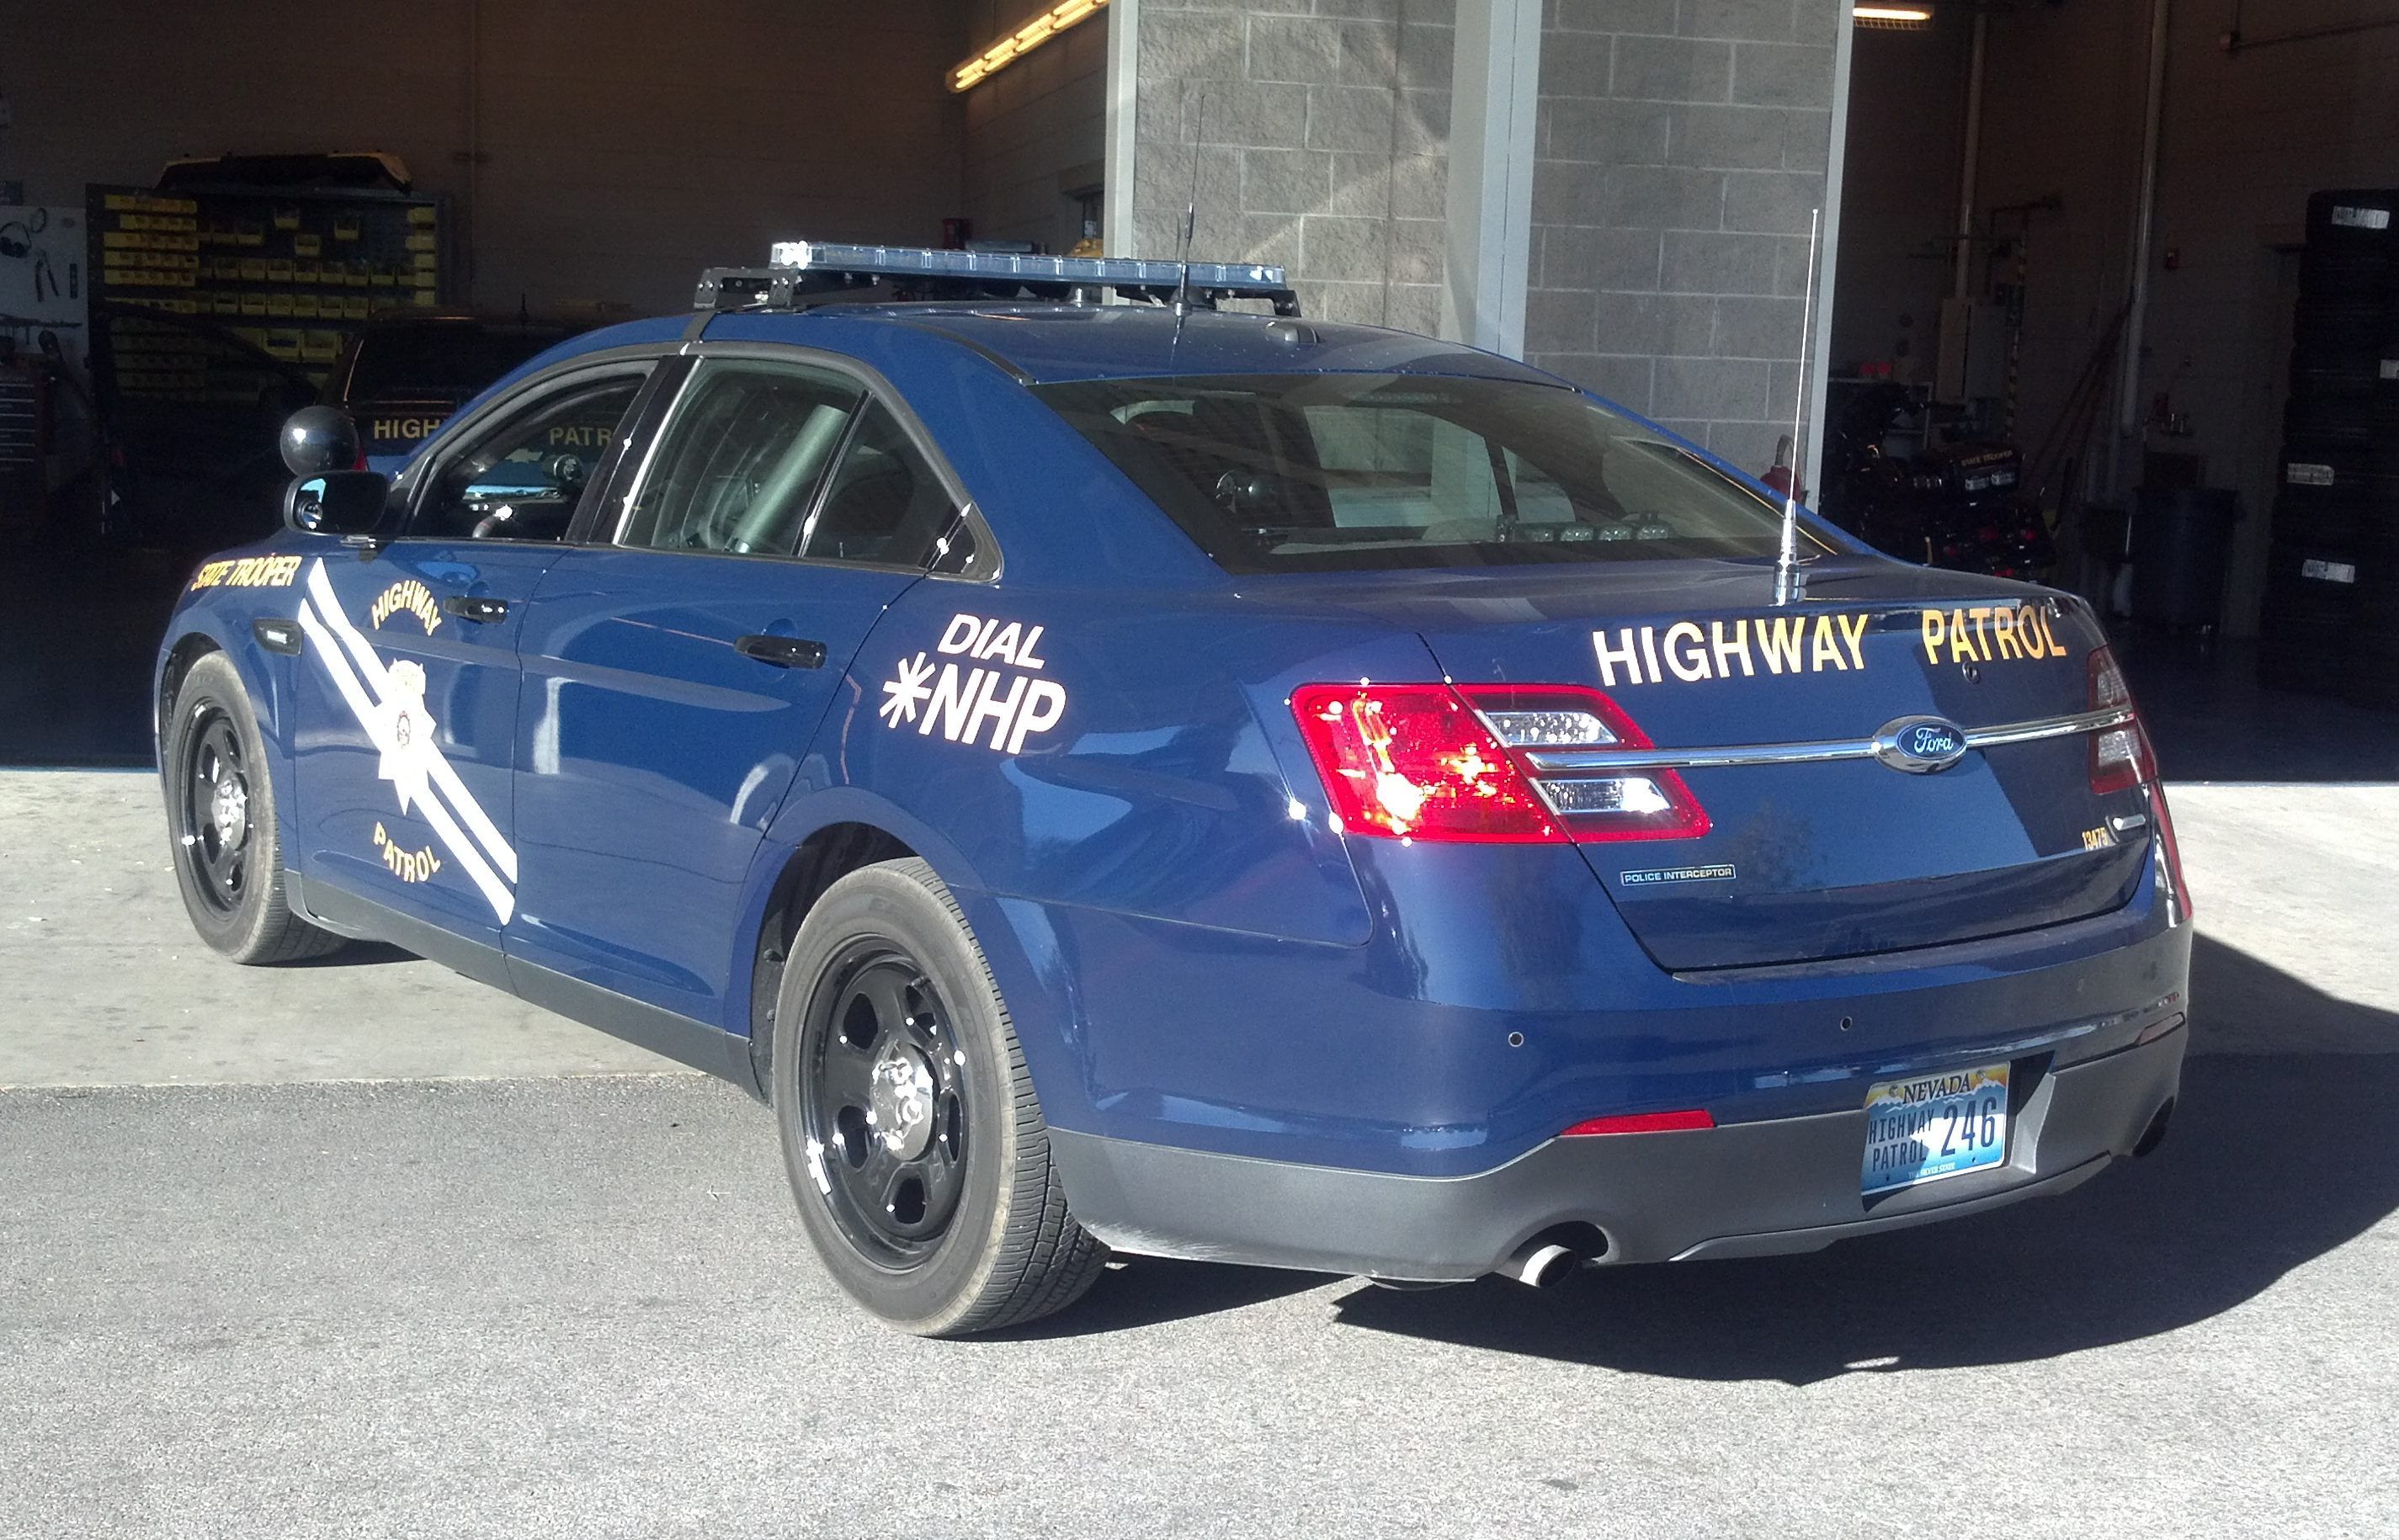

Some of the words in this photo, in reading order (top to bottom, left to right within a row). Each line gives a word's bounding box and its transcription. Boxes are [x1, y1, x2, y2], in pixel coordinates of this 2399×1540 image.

[374, 418, 443, 439] HIGH
[550, 427, 614, 446] PATR
[226, 555, 302, 587] TROOPER
[372, 580, 442, 636] HIGHWAY
[937, 613, 1045, 670] DIAL
[1593, 613, 1870, 687] HIGHWAY
[1922, 606, 2067, 665] PATROL
[1913, 727, 1954, 753] Ford
[373, 821, 441, 884] PATROL
[1625, 872, 1662, 883] POLICE
[1663, 868, 1732, 881] INTERCEPTOR
[1902, 1073, 1971, 1105] NEVADA
[1869, 1108, 1934, 1144] HIGHWAY
[1941, 1097, 1997, 1157] 246
[1872, 1139, 1927, 1172] PATROL
